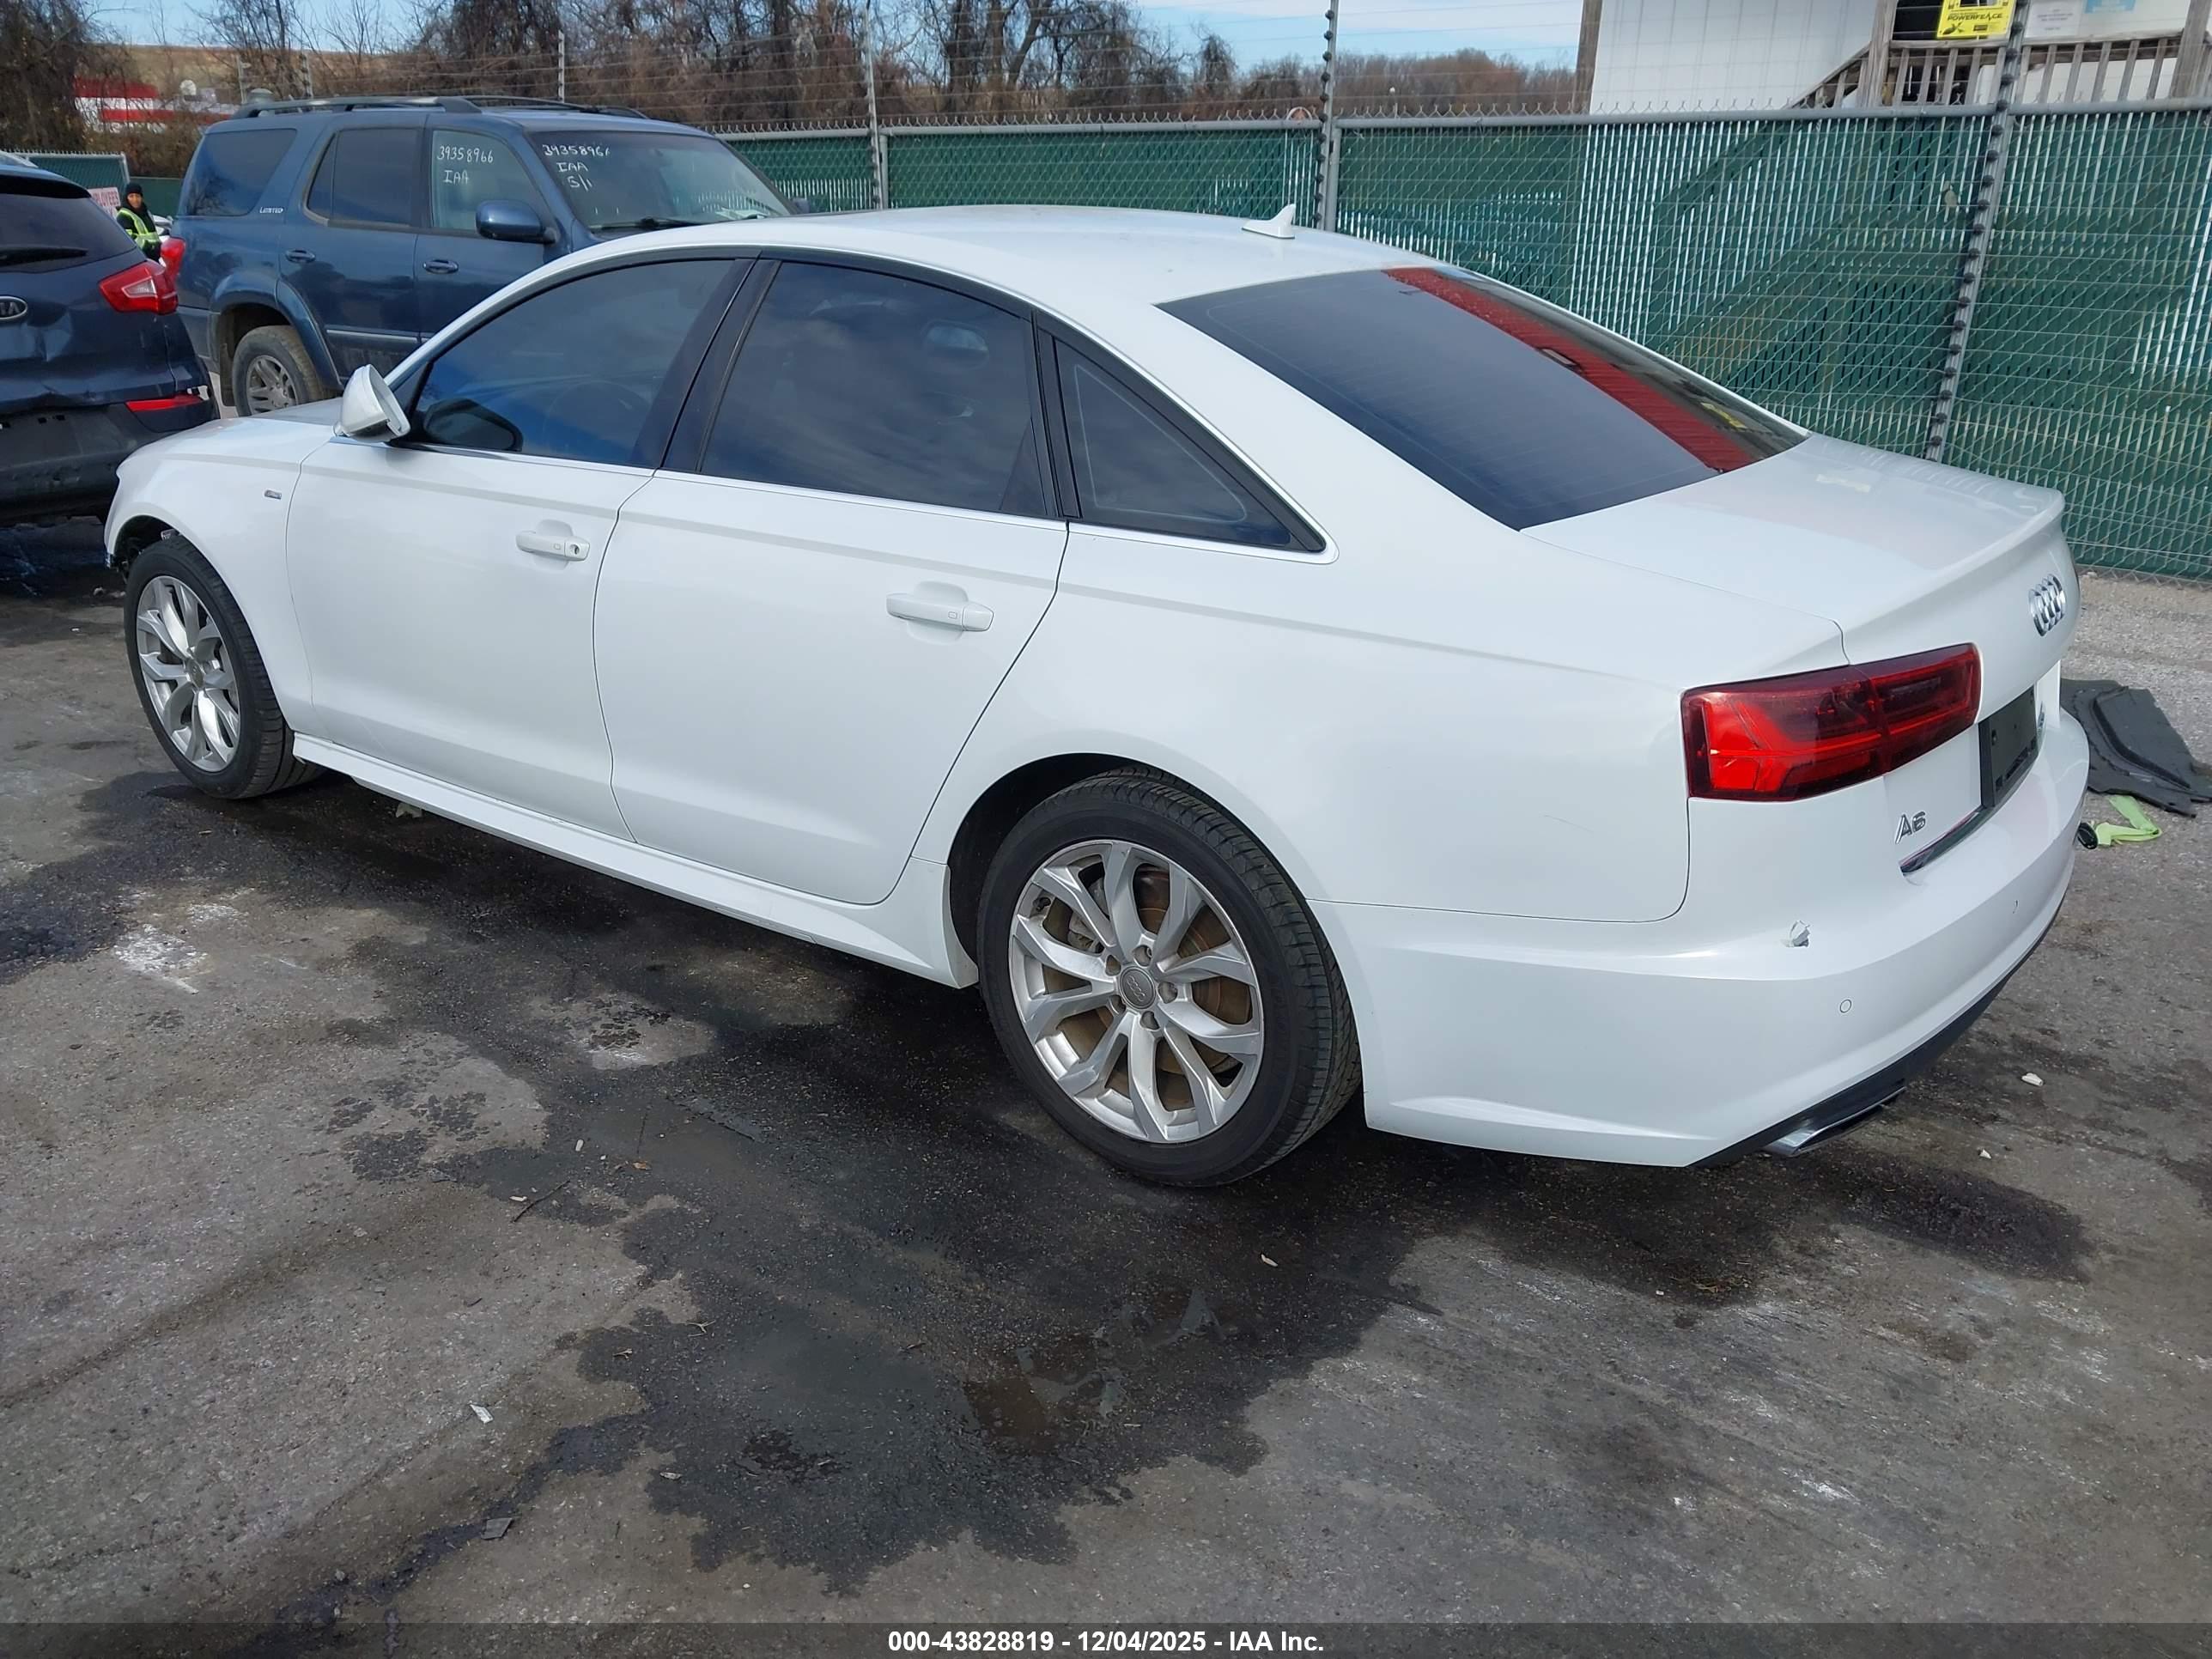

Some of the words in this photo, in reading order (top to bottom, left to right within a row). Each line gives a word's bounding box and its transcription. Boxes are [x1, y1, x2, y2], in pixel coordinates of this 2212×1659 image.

[436, 145, 494, 163] 39358966
[556, 161, 589, 173] IAA
[442, 169, 470, 185] IAA
[1894, 811, 1927, 845] A6
